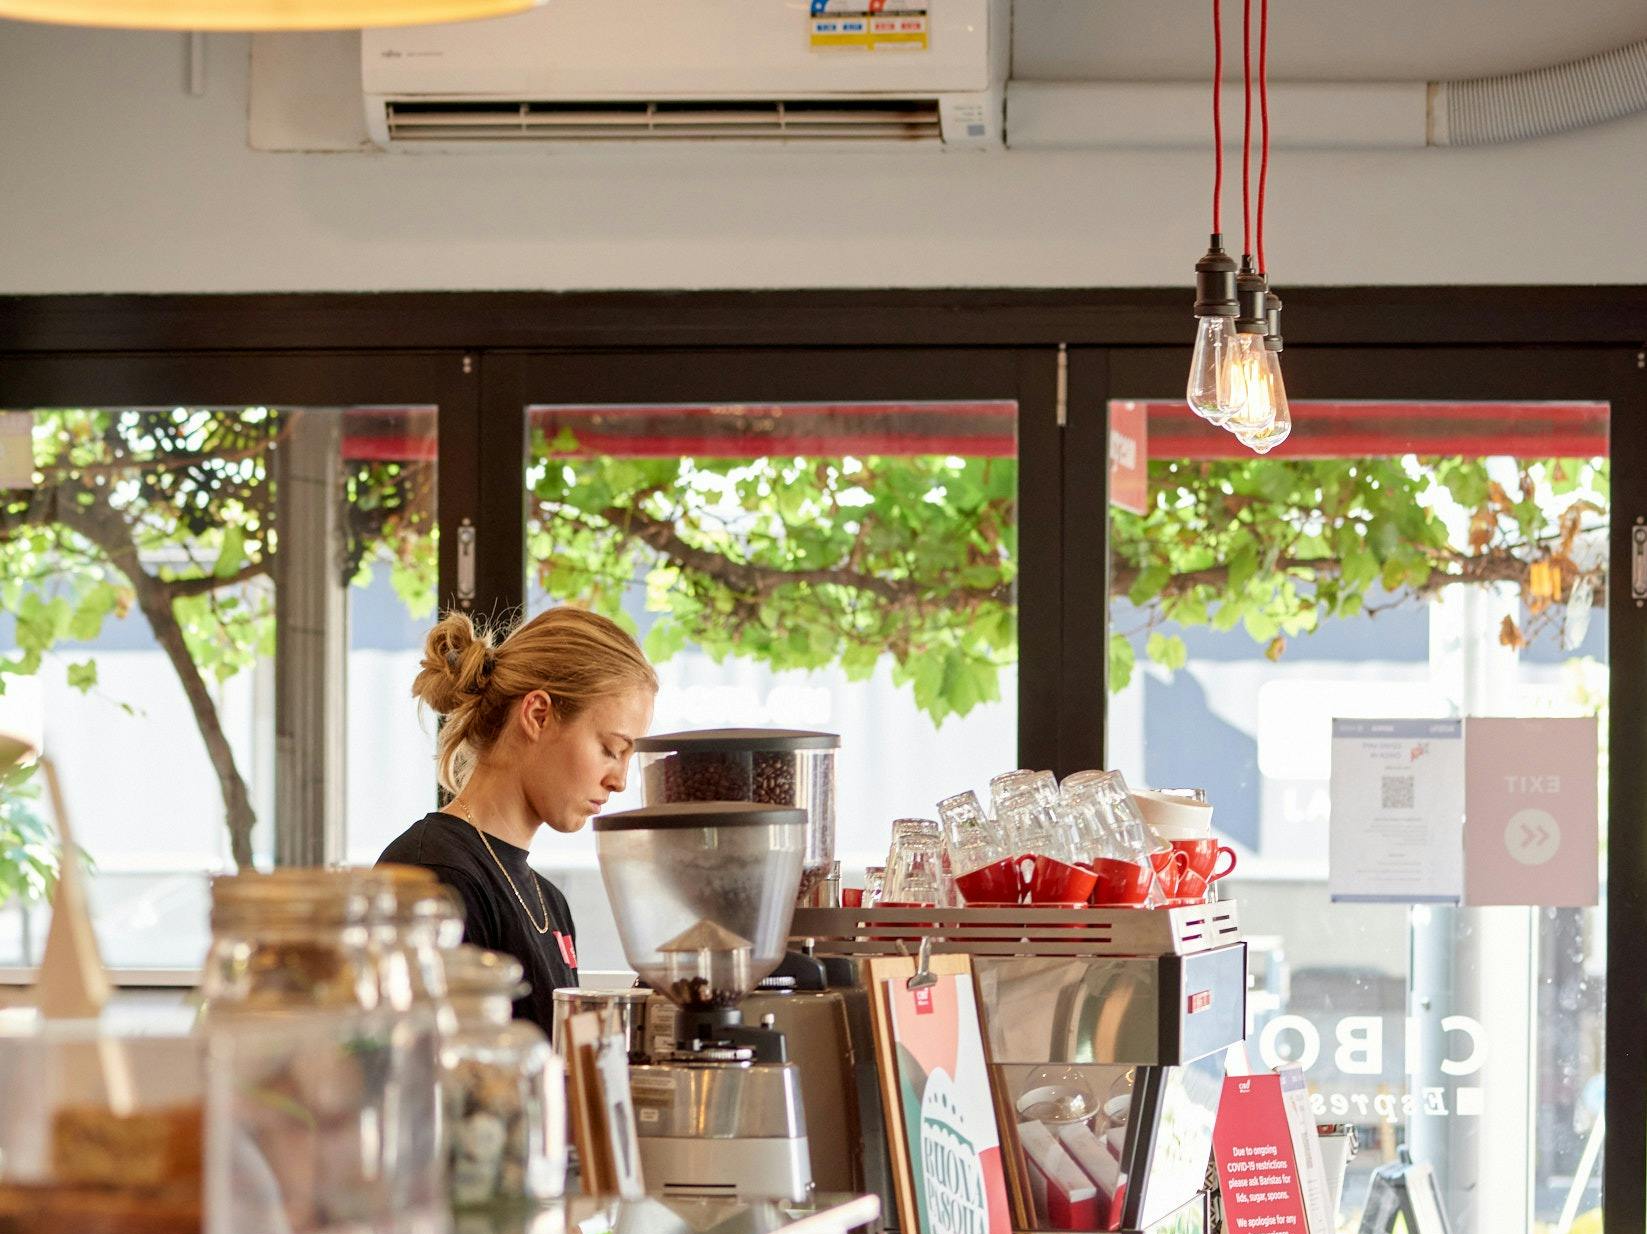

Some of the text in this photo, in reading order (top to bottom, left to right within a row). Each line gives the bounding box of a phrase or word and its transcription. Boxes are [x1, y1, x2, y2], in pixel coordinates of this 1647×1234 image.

[1232, 1144, 1277, 1157] Due to ongoing
[1227, 1159, 1288, 1172] COVID-19 restrictions
[1228, 1174, 1291, 1190] please ask Baristas for
[1236, 1191, 1289, 1204] lids, sugar, spoons.
[1236, 1214, 1297, 1228] We apologise for any
